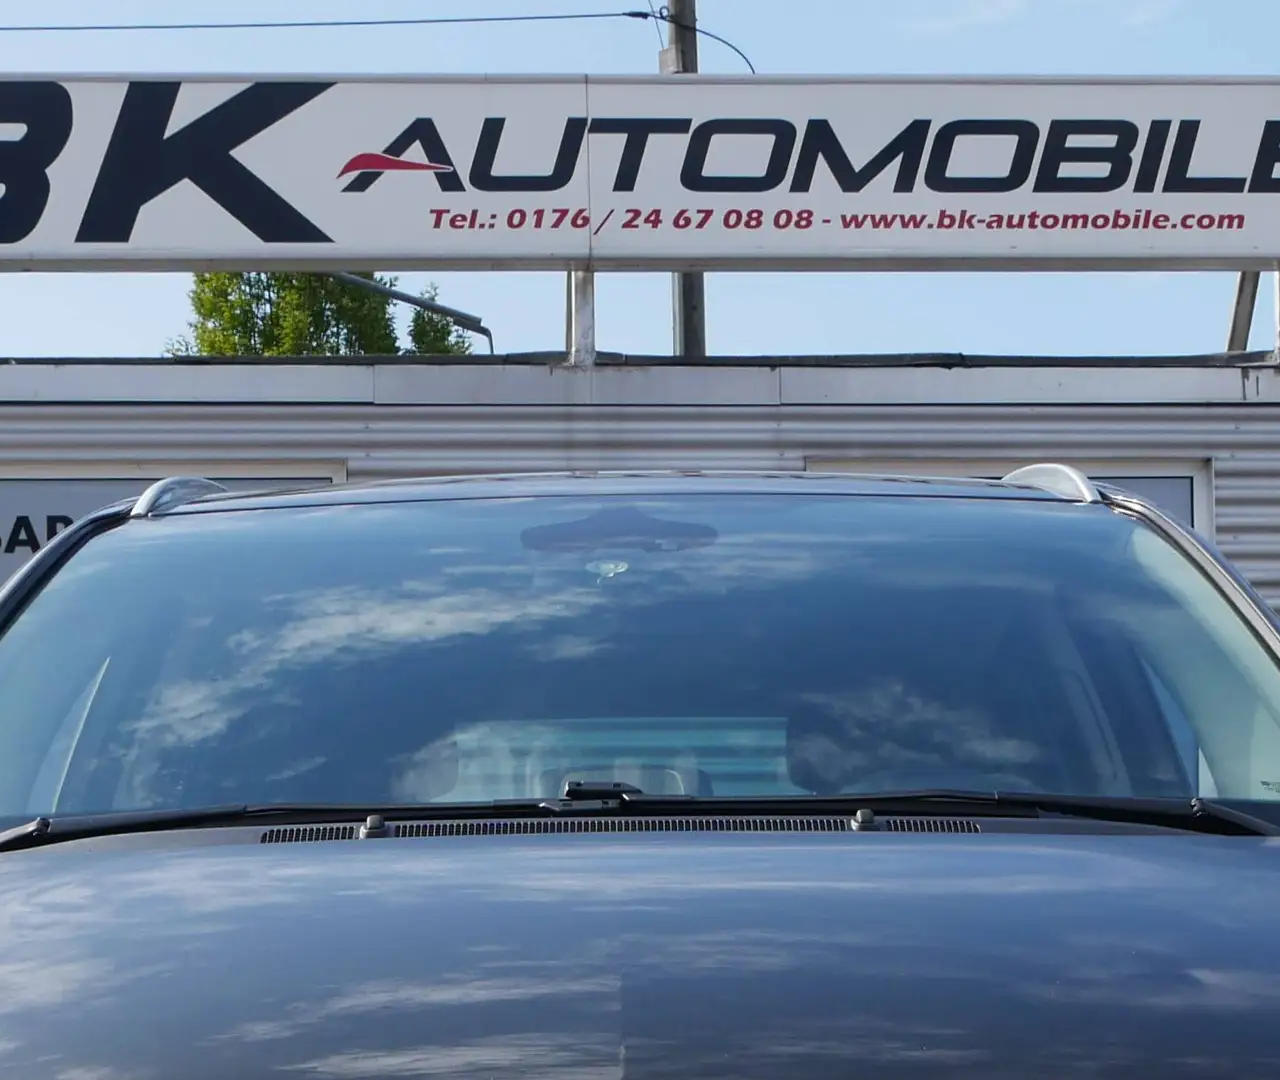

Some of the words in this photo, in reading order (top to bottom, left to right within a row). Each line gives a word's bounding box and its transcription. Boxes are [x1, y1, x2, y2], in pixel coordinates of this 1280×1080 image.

[429, 208, 497, 229] Tel.:
[506, 208, 591, 229] 0176
[621, 208, 663, 229] 24
[672, 208, 714, 229] 67
[723, 208, 763, 229] 08
[773, 208, 814, 229] 08
[840, 208, 1246, 230] www.bk-automobile.com
